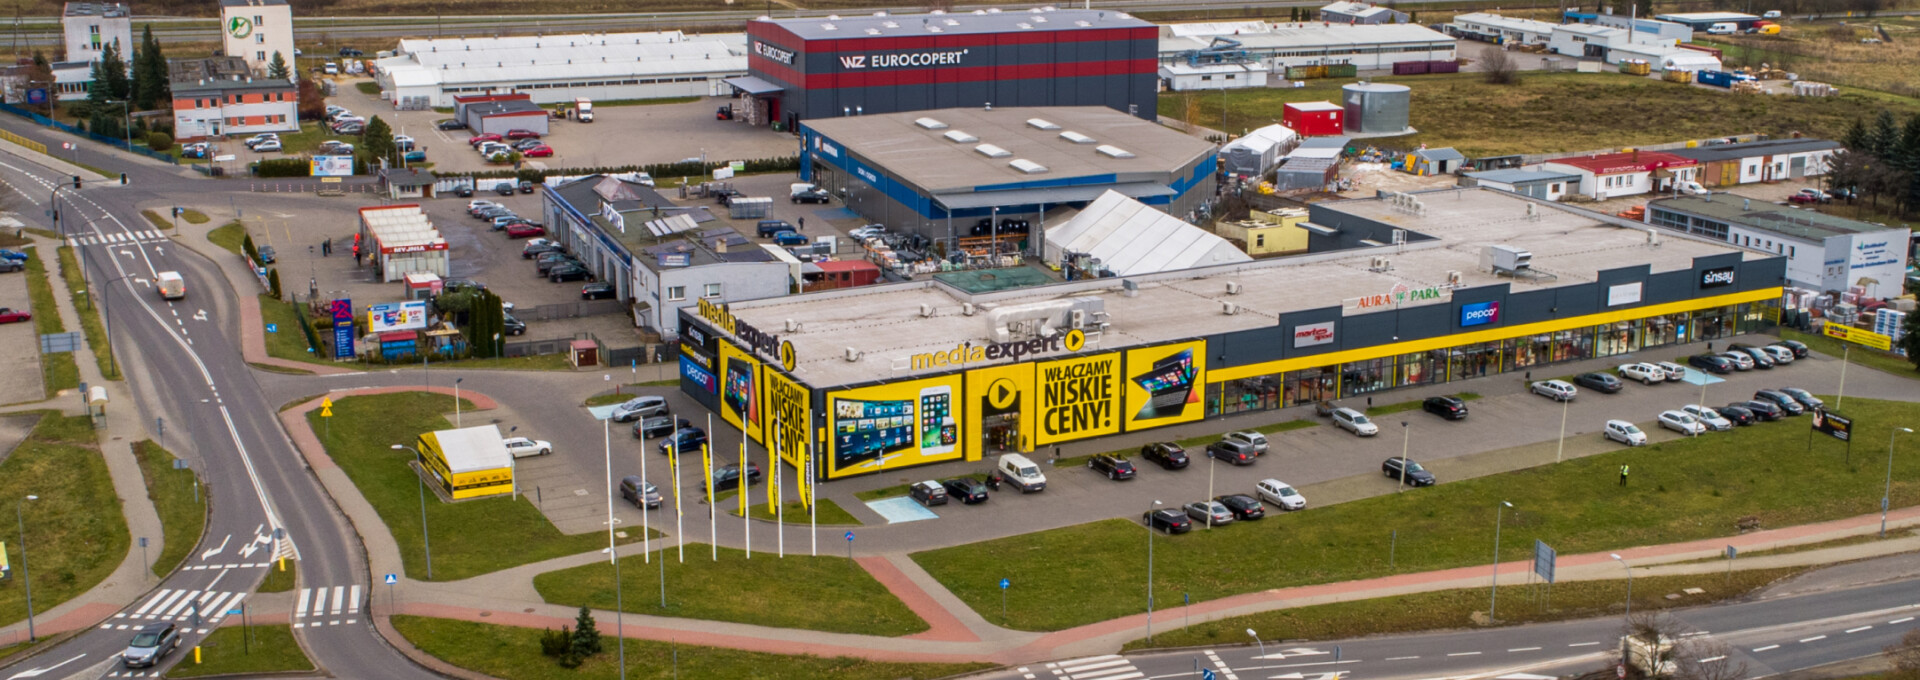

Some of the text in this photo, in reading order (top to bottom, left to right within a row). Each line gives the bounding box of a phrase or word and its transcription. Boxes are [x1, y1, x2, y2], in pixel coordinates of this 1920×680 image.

[840, 52, 963, 69] WZ EUROCOPERT
[1704, 270, 1734, 284] sinsay
[1357, 287, 1440, 309] AURA PARK
[1466, 308, 1494, 320] pepco
[697, 297, 780, 360] mediaexpert
[1296, 327, 1328, 339] martes
[1314, 332, 1333, 342] sport
[911, 334, 1060, 371] mediaexpert
[687, 364, 707, 385] pepco
[1045, 374, 1112, 408] NISKIE
[771, 389, 804, 434] NISKIE
[1044, 400, 1111, 436] CENY!
